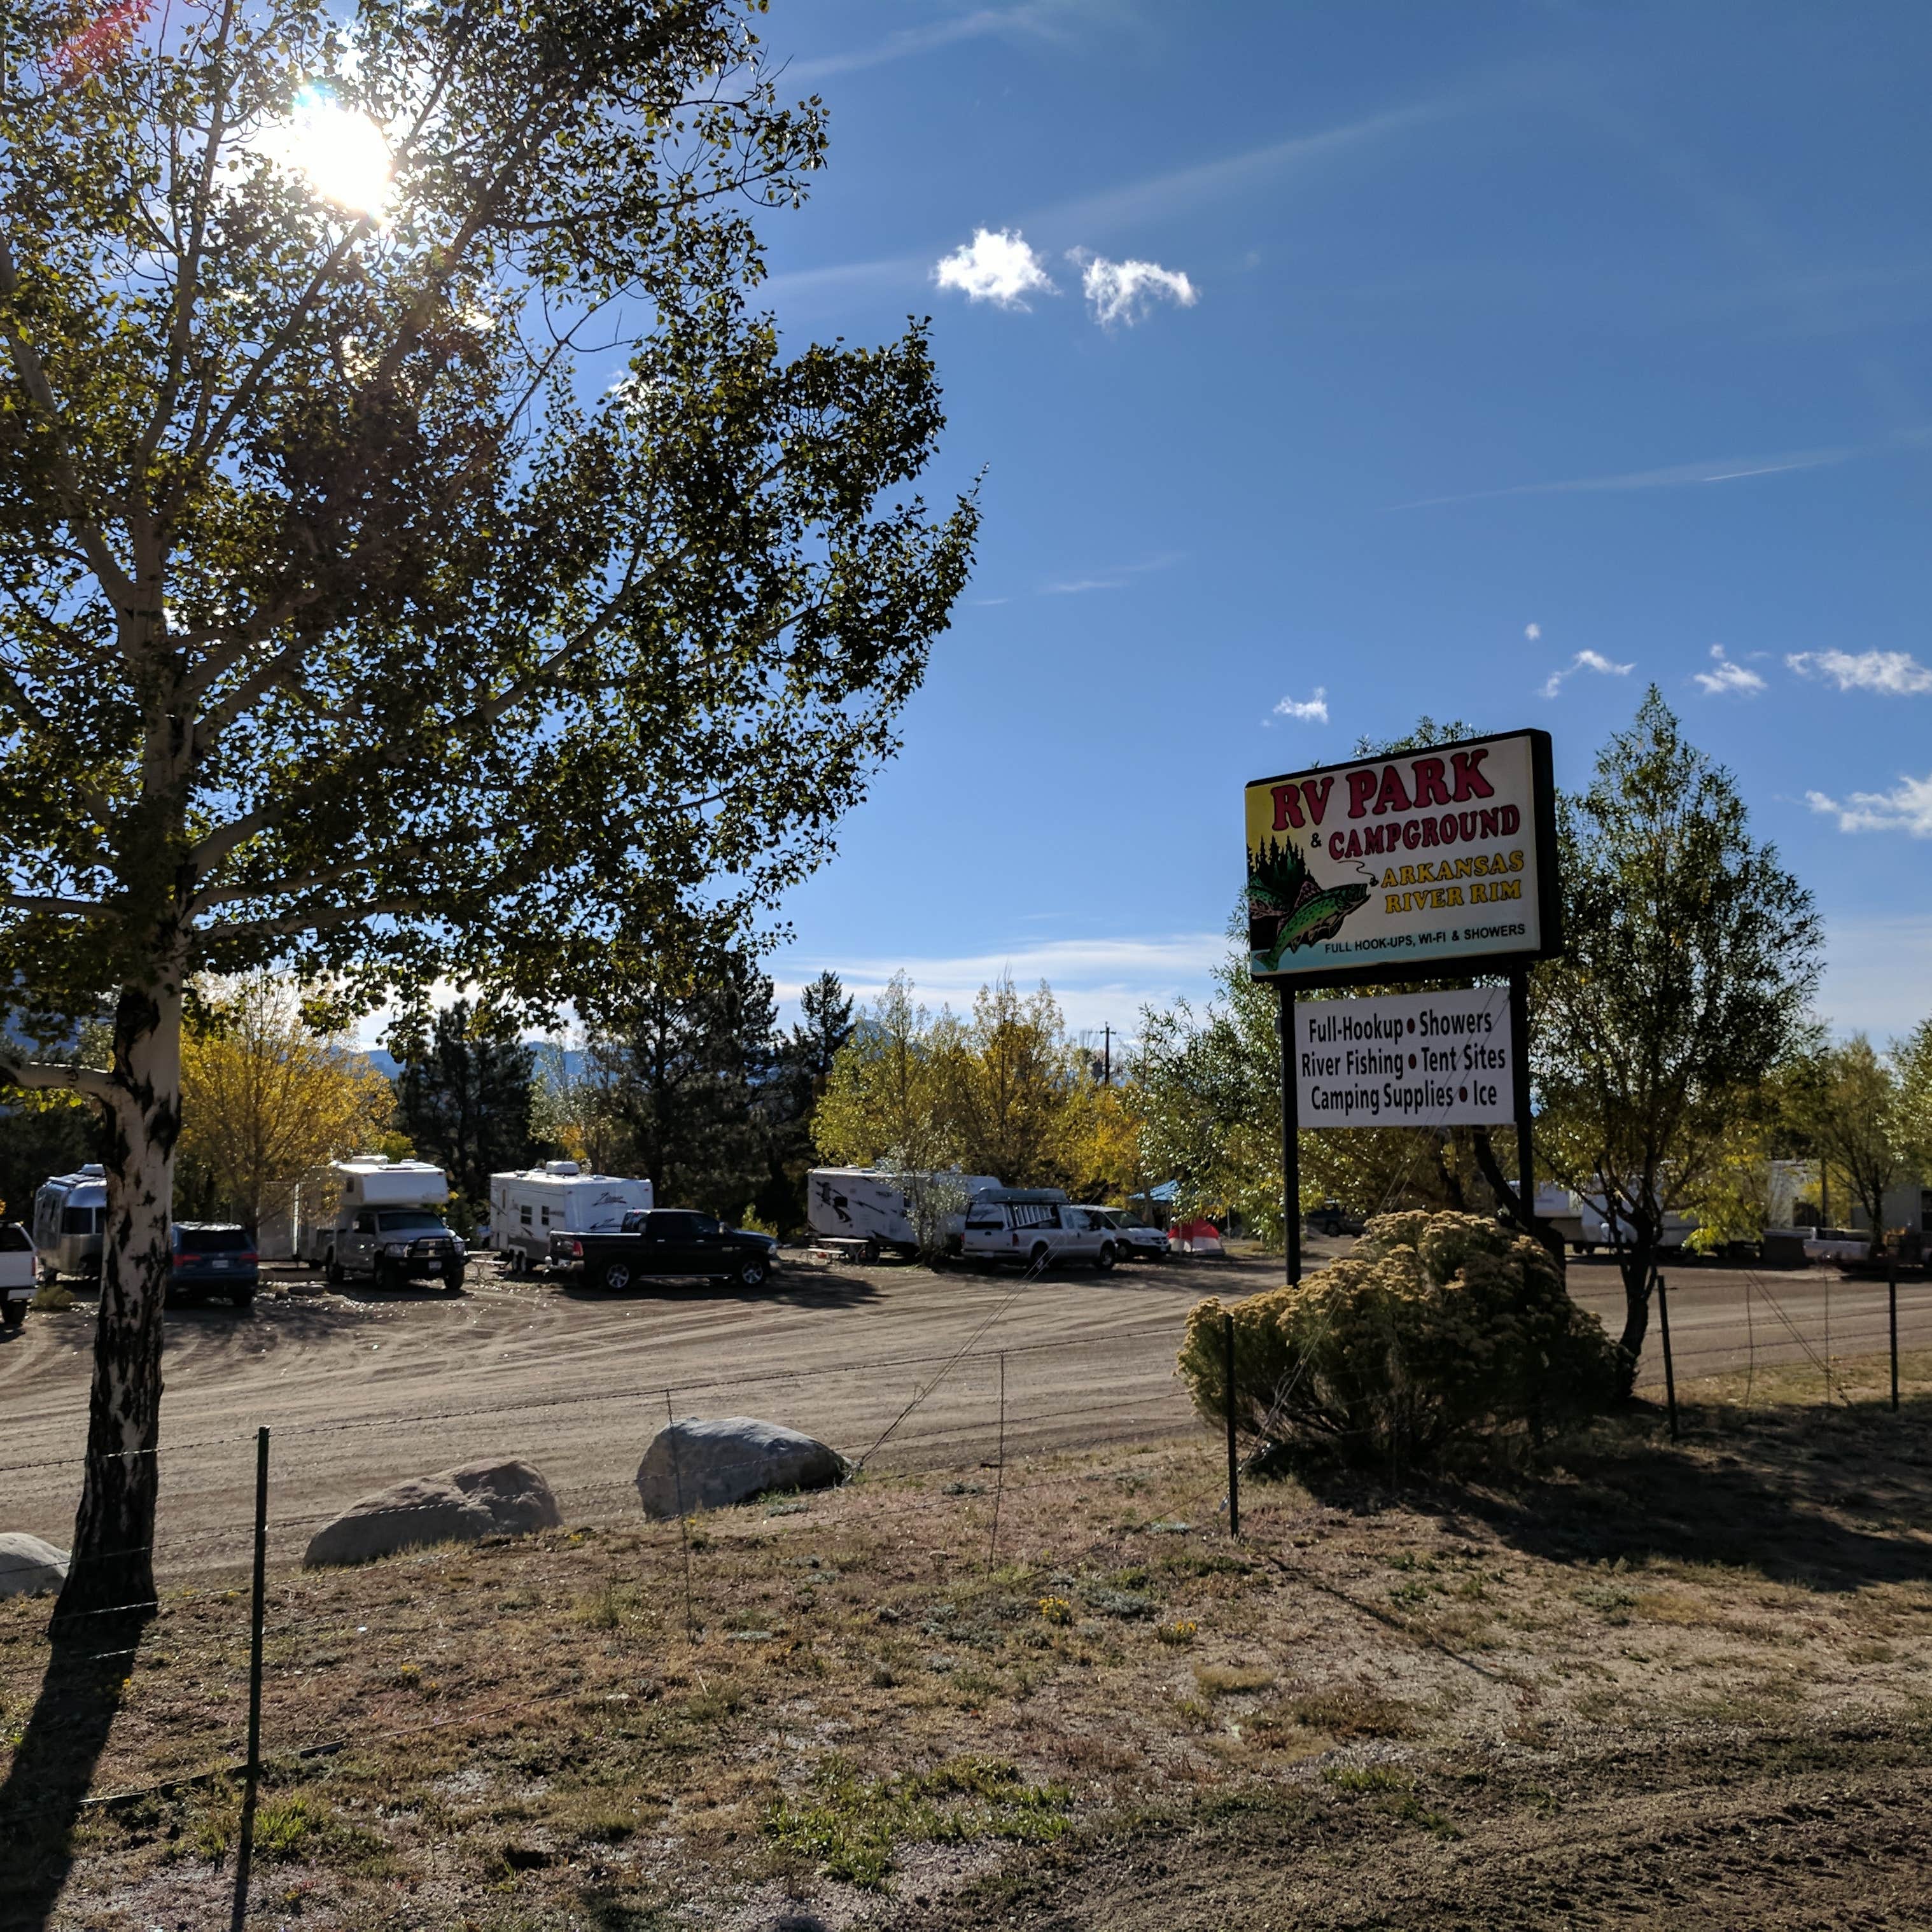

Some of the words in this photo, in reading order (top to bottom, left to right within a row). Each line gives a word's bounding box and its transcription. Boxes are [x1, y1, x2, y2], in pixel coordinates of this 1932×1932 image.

[1271, 776, 1334, 831] RV
[1345, 748, 1495, 819] PARK
[1310, 832, 1322, 848] &
[1328, 804, 1520, 861] CAMPGROUND
[1380, 850, 1524, 888] ARKANSAS
[1385, 886, 1464, 914] RIVER
[1470, 879, 1522, 905] RIM
[1325, 941, 1351, 954] FULL
[1355, 935, 1416, 951] HOOK-UPS,
[1418, 931, 1446, 946] WI-FI
[1452, 930, 1460, 942] &
[1464, 923, 1525, 941] SHOWERS
[1309, 1013, 1403, 1044] Full-Hookup
[1420, 1009, 1492, 1037] Showers
[1301, 1051, 1341, 1077] River
[1347, 1048, 1403, 1080] Fishing
[1421, 1045, 1457, 1072] Tent
[1464, 1043, 1506, 1070] Sites
[1311, 1083, 1380, 1116] Camping
[1383, 1080, 1453, 1114] Supplies
[1473, 1079, 1497, 1106] Ice
